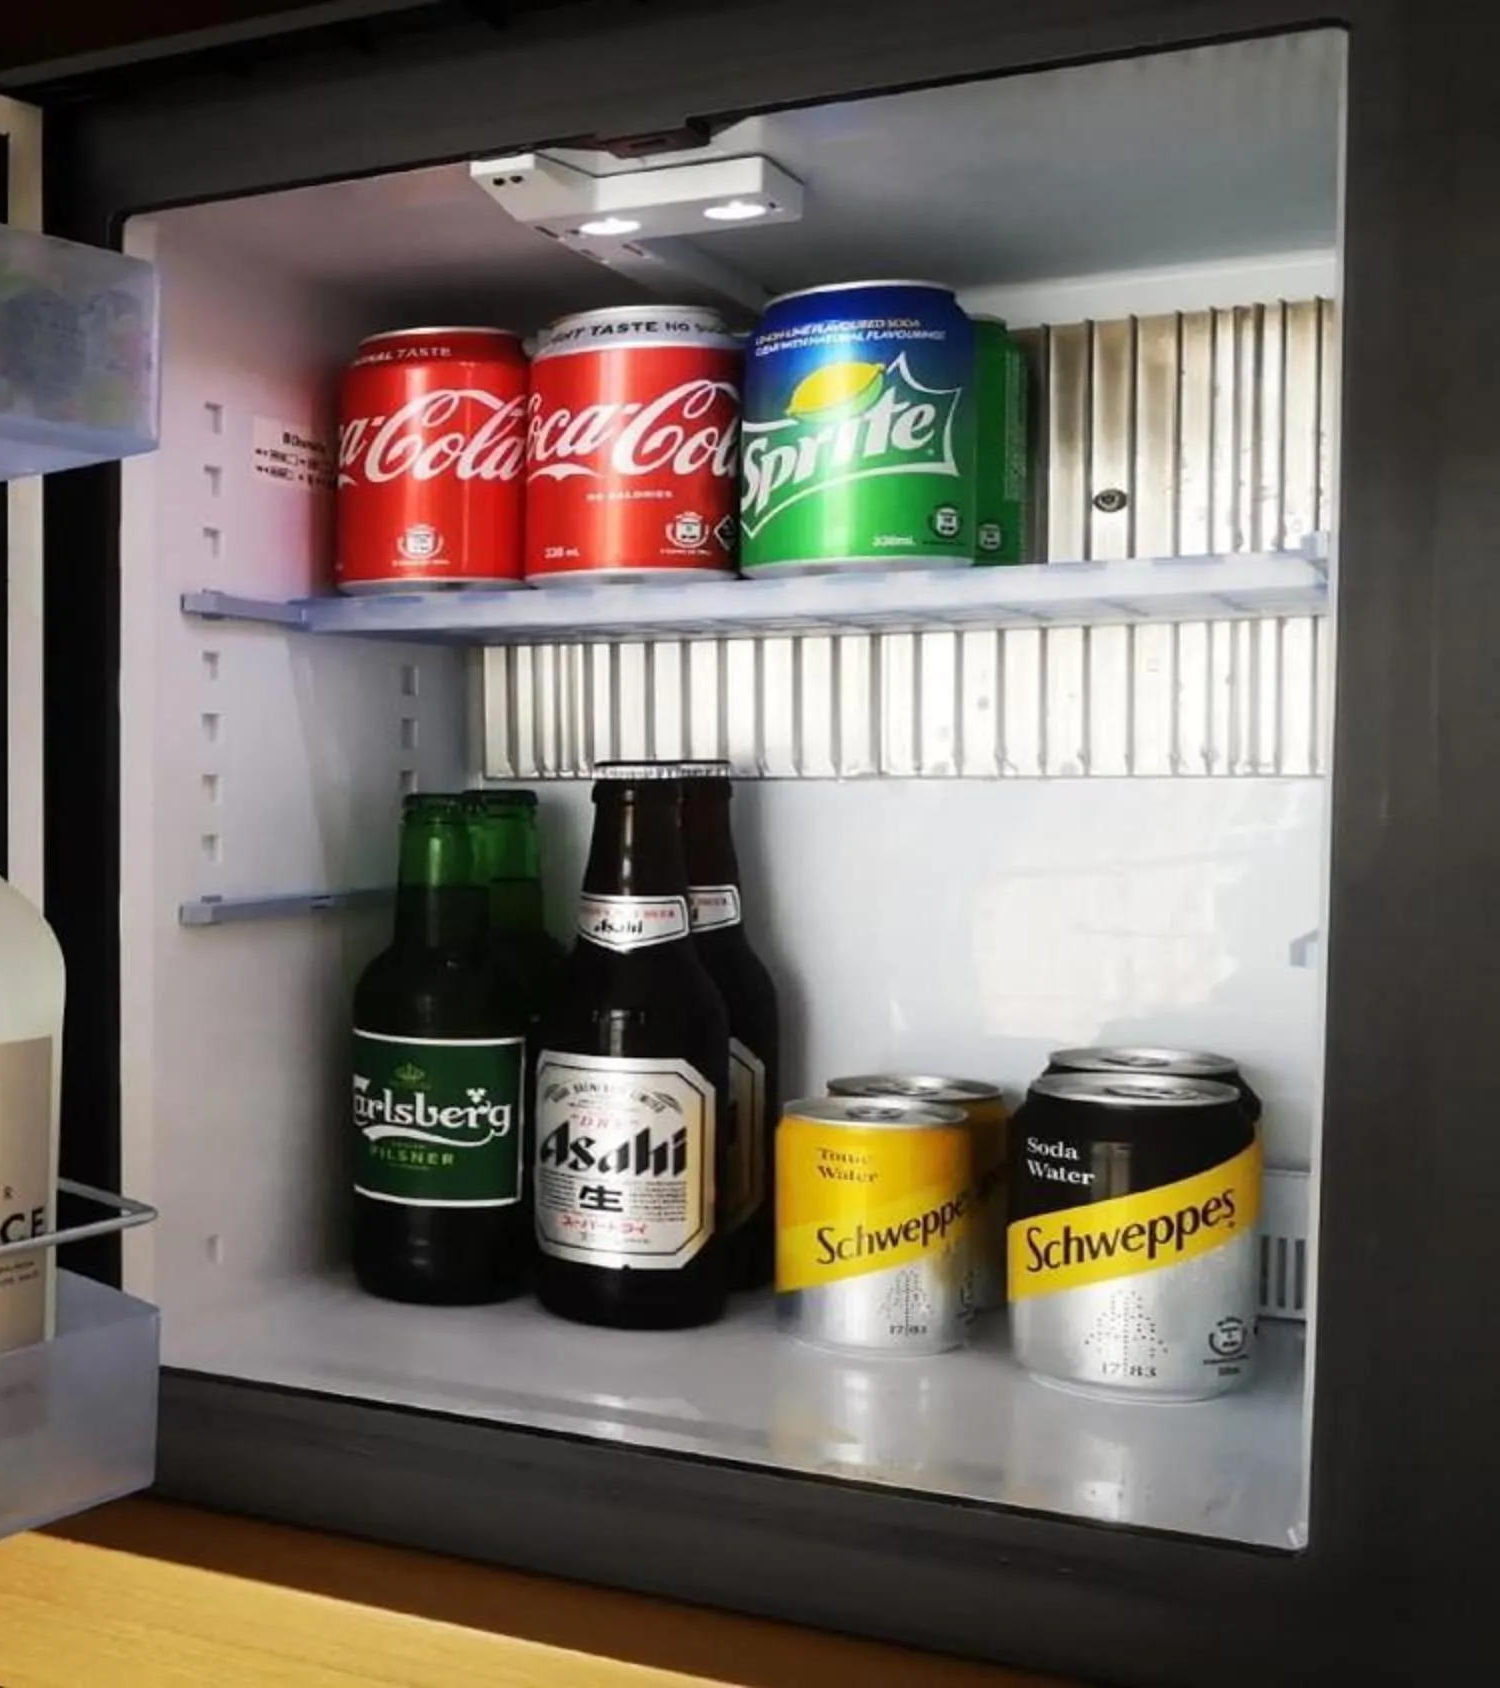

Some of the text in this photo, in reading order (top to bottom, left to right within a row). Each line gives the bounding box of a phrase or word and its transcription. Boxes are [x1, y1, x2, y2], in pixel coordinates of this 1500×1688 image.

[590, 321, 659, 336] TASTE
[396, 346, 452, 359] TASTE
[338, 388, 527, 483] a-Cola
[741, 386, 935, 517] Sprite
[370, 1144, 455, 1166] PILSNER
[540, 1119, 688, 1177] Asahi
[1026, 1136, 1079, 1161] Soda
[816, 1165, 879, 1182] Water
[1026, 1159, 1096, 1186] Water
[579, 1185, 624, 1213] 生
[1026, 1189, 1236, 1274] Schweppes
